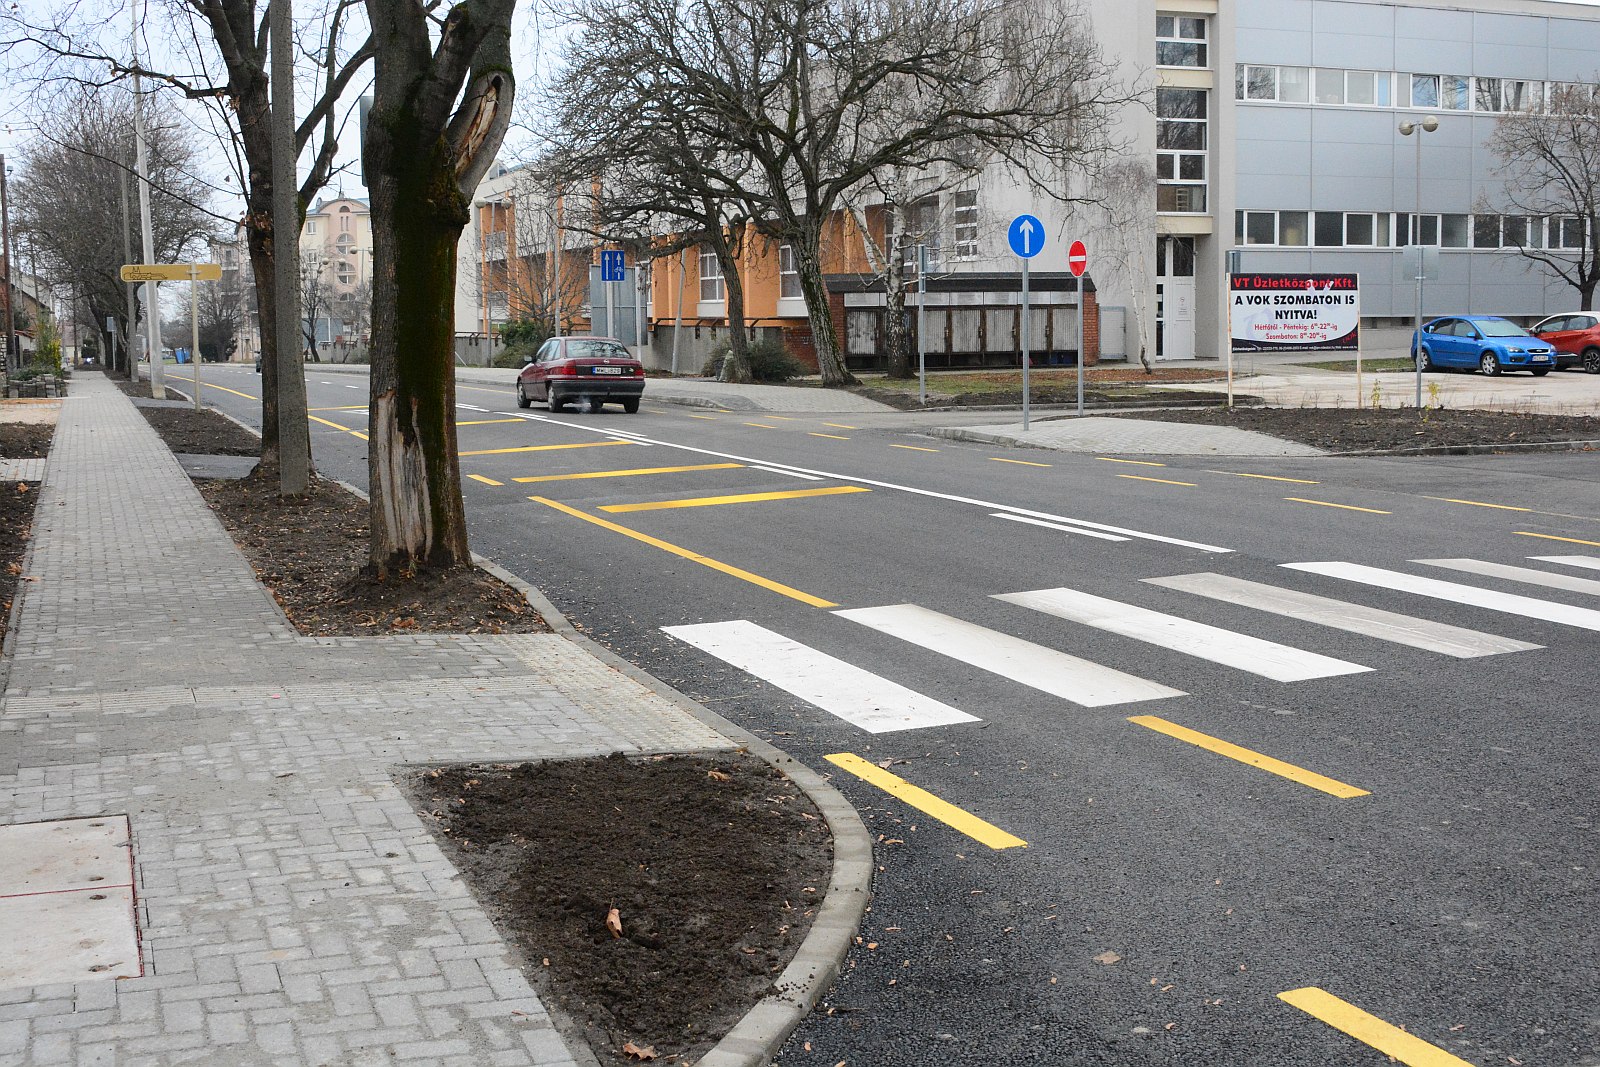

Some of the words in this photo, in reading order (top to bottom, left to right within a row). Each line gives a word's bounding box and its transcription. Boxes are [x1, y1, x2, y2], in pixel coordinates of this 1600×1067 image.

[1233, 277, 1249, 288] VT
[1253, 276, 1331, 289] Üzletközpont
[1334, 277, 1356, 288] Kft.
[1235, 295, 1243, 305] A
[1246, 295, 1270, 305] VOK
[1273, 295, 1341, 305] SZOMBATON
[1345, 295, 1355, 305] IS
[1275, 310, 1317, 320] NYITVA!
